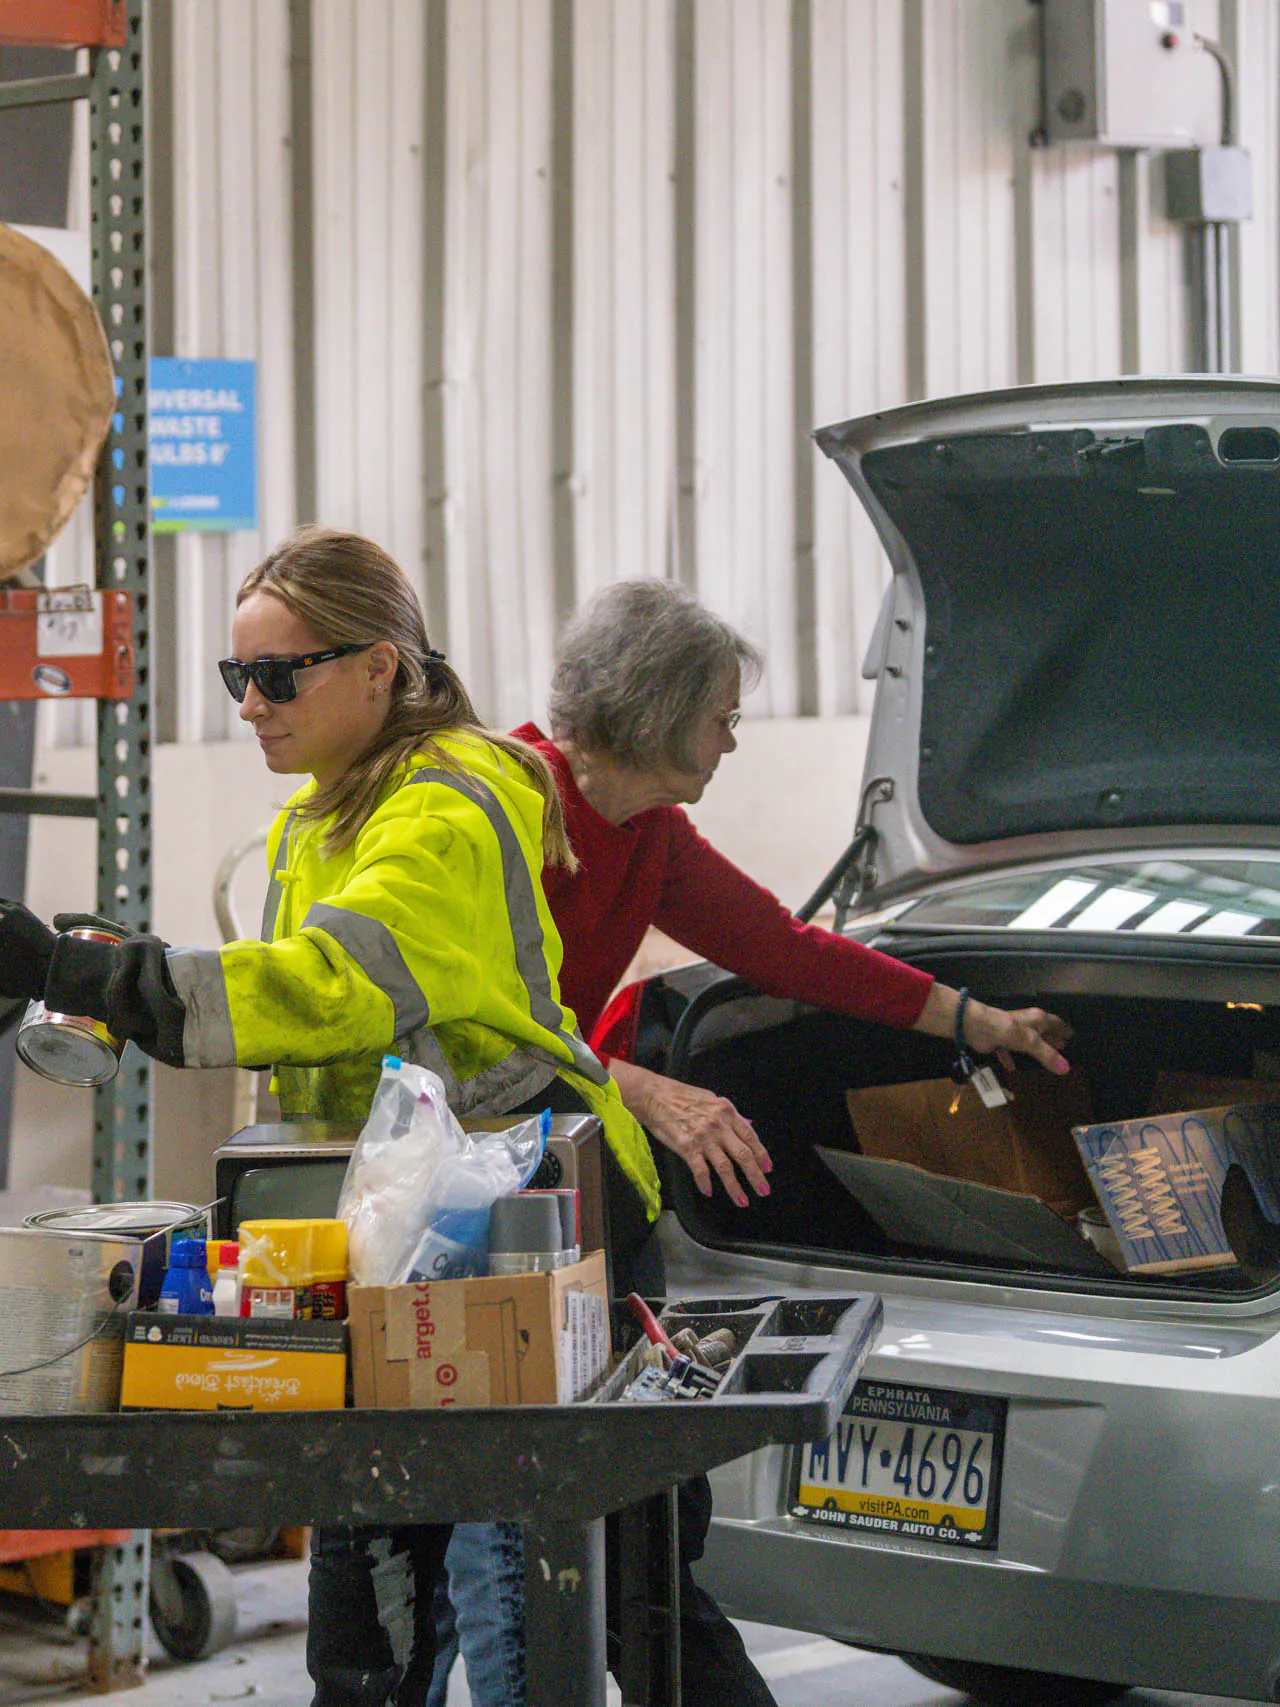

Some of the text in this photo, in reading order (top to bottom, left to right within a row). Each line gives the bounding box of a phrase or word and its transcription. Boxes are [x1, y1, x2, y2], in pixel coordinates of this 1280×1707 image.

[175, 1372, 301, 1397] Breakfast Blend
[867, 1386, 931, 1403] EPHRATA
[852, 1399, 951, 1422] PENNSYLVANIA
[859, 1498, 930, 1521] visitPA.com
[812, 1510, 961, 1540] JOHN SAUDER AUTO CO.
